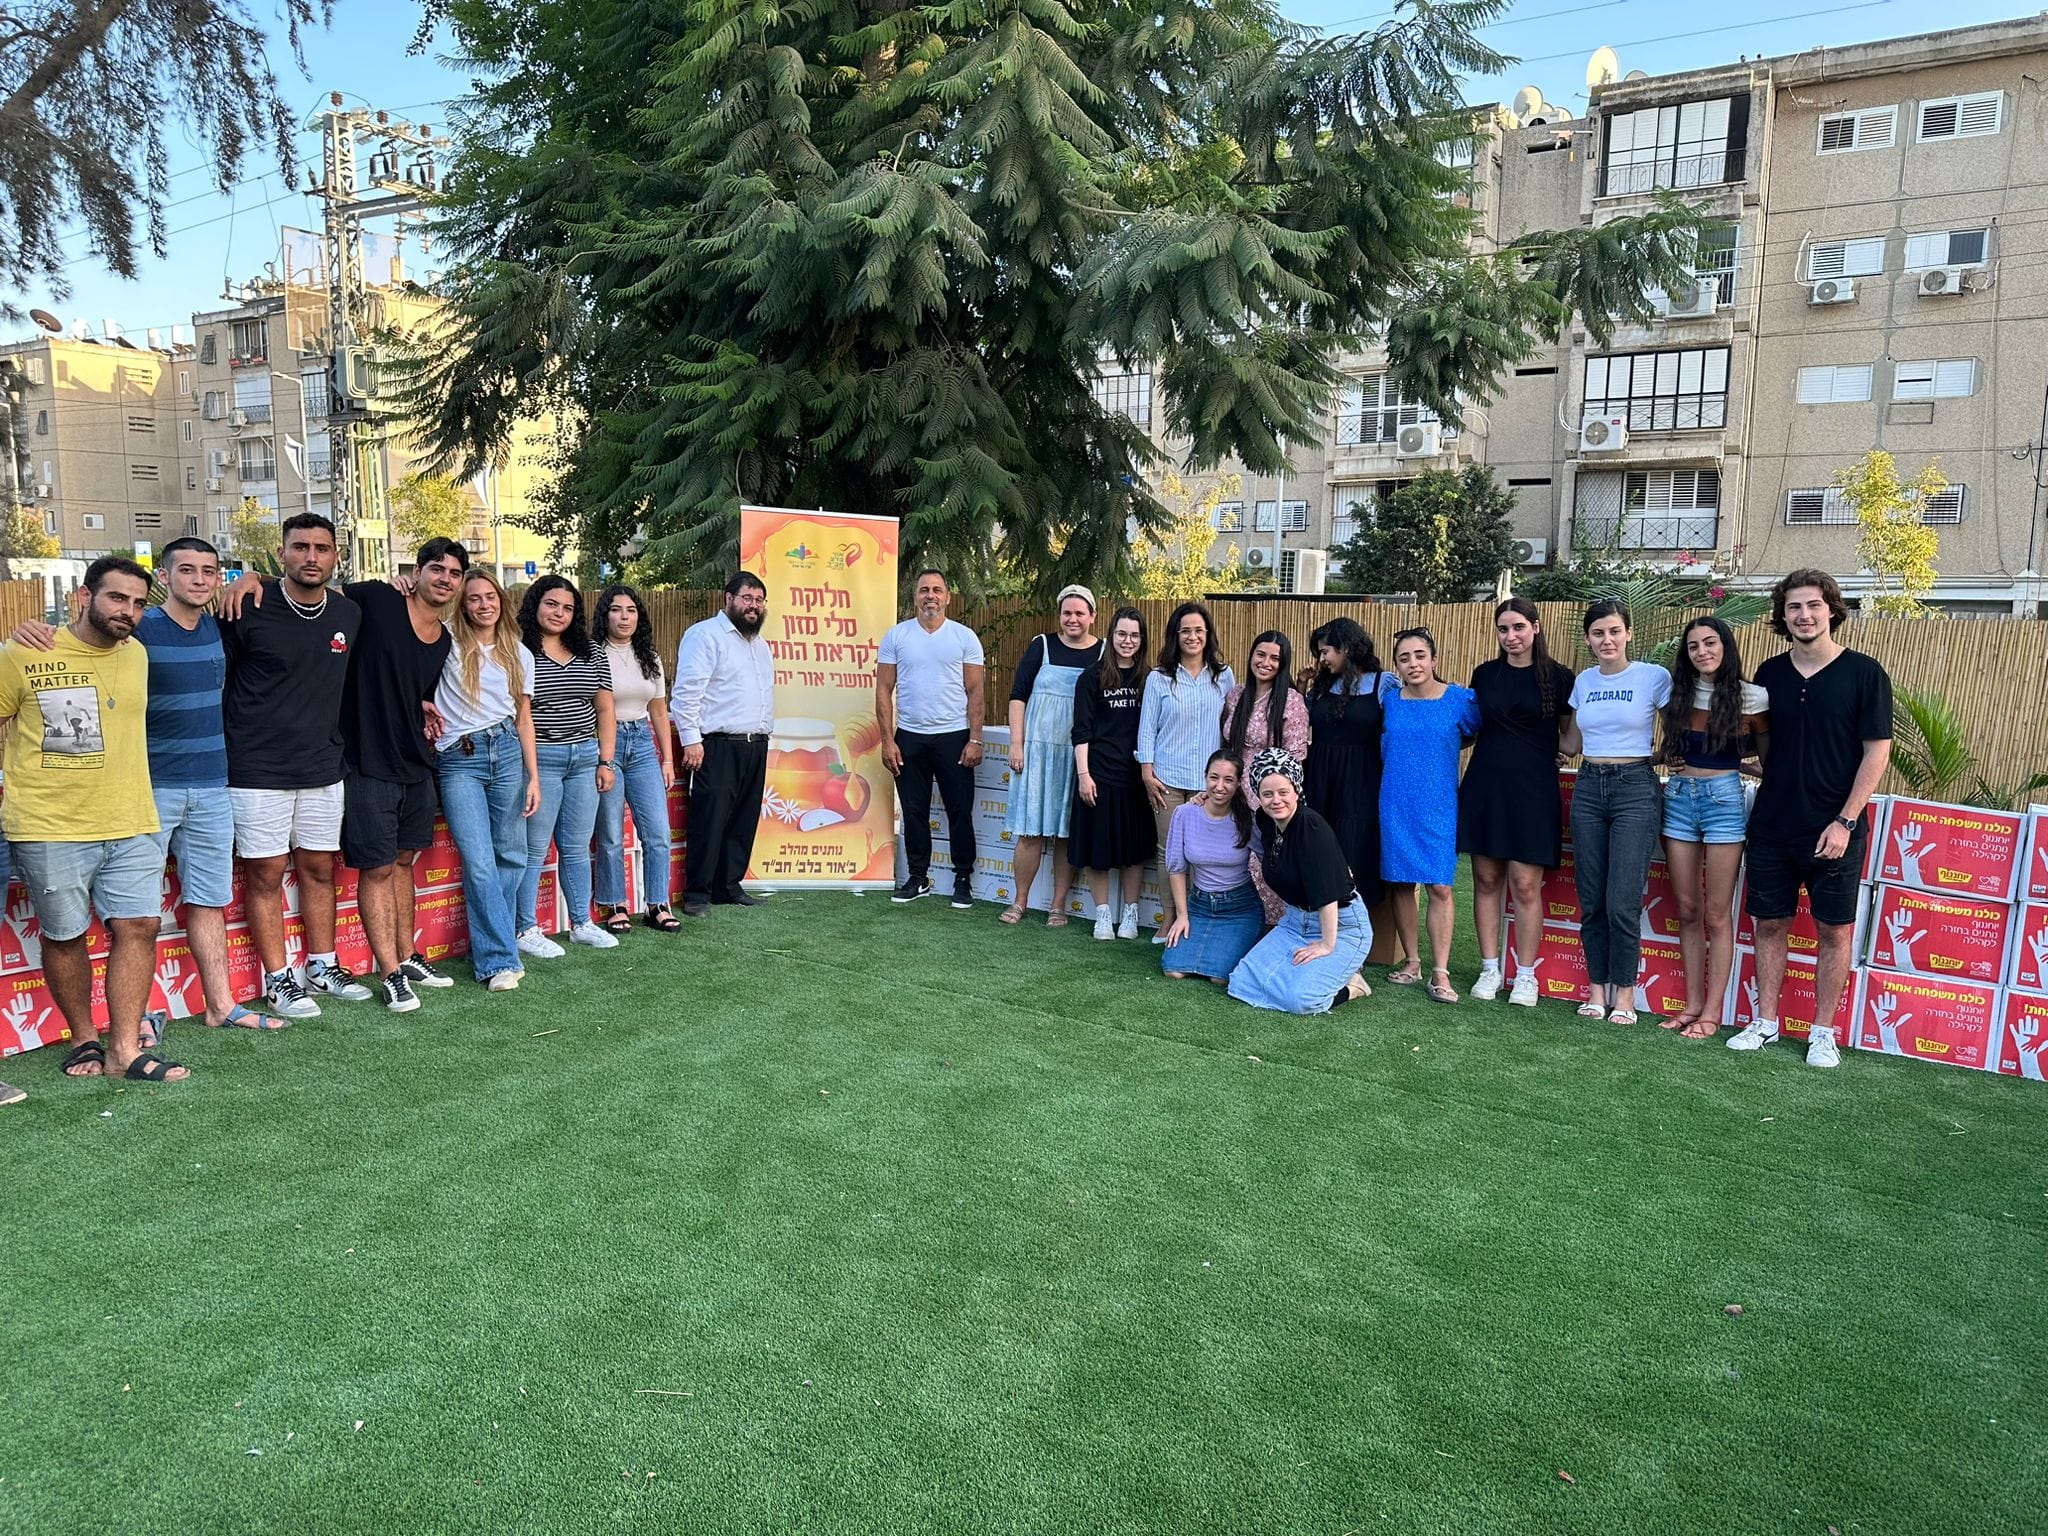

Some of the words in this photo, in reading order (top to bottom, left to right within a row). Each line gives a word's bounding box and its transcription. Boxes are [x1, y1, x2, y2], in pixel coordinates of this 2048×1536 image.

[789, 581, 851, 613] חלוקת
[782, 614, 818, 640] מזון
[824, 610, 857, 637] סלי
[814, 638, 879, 670] לקראת
[25, 661, 67, 675] MIND
[31, 675, 90, 690] MATTER
[797, 671, 825, 687] אור
[1585, 690, 1633, 704] COLORADO
[1109, 699, 1128, 709] TAKE
[1130, 699, 1136, 707] IT
[1908, 810, 1937, 823] אחת!
[1939, 816, 1983, 830] משפחה
[1985, 822, 2012, 835] כולנו
[1950, 838, 1979, 849] בחזרה
[1981, 833, 2010, 844] יוחננוף
[779, 842, 808, 855] מהלב
[811, 845, 843, 855] נותנים
[1981, 843, 2009, 853] נותנים
[1971, 849, 2007, 862] לקהילה
[762, 859, 792, 873] חב"ד
[1940, 869, 1969, 882] יוחננוף
[420, 899, 449, 911] משפחה
[1898, 896, 1927, 910] אחת!
[1930, 903, 1972, 917] משפחה
[1974, 909, 2001, 921] כולנו
[1940, 924, 1969, 935] בחזרה
[1971, 919, 2000, 931] יוחננוף
[1545, 933, 1579, 946] משפחה
[1971, 929, 1998, 939] נותנים
[1962, 936, 1997, 948] לקהילה
[164, 946, 191, 958] אחת!
[1554, 952, 1578, 962] בחזרה
[13, 977, 46, 992] אחת!
[1883, 980, 1912, 993] אחת!
[1914, 986, 1956, 1001] משפחה
[1958, 992, 1986, 1005] כולנו
[1925, 1008, 1954, 1019] בחזרה
[1956, 1004, 1985, 1015] יוחננוף
[2024, 1003, 2048, 1017] חת!
[1956, 1013, 1984, 1024] נותנים
[1947, 1021, 1983, 1033] לקהילה
